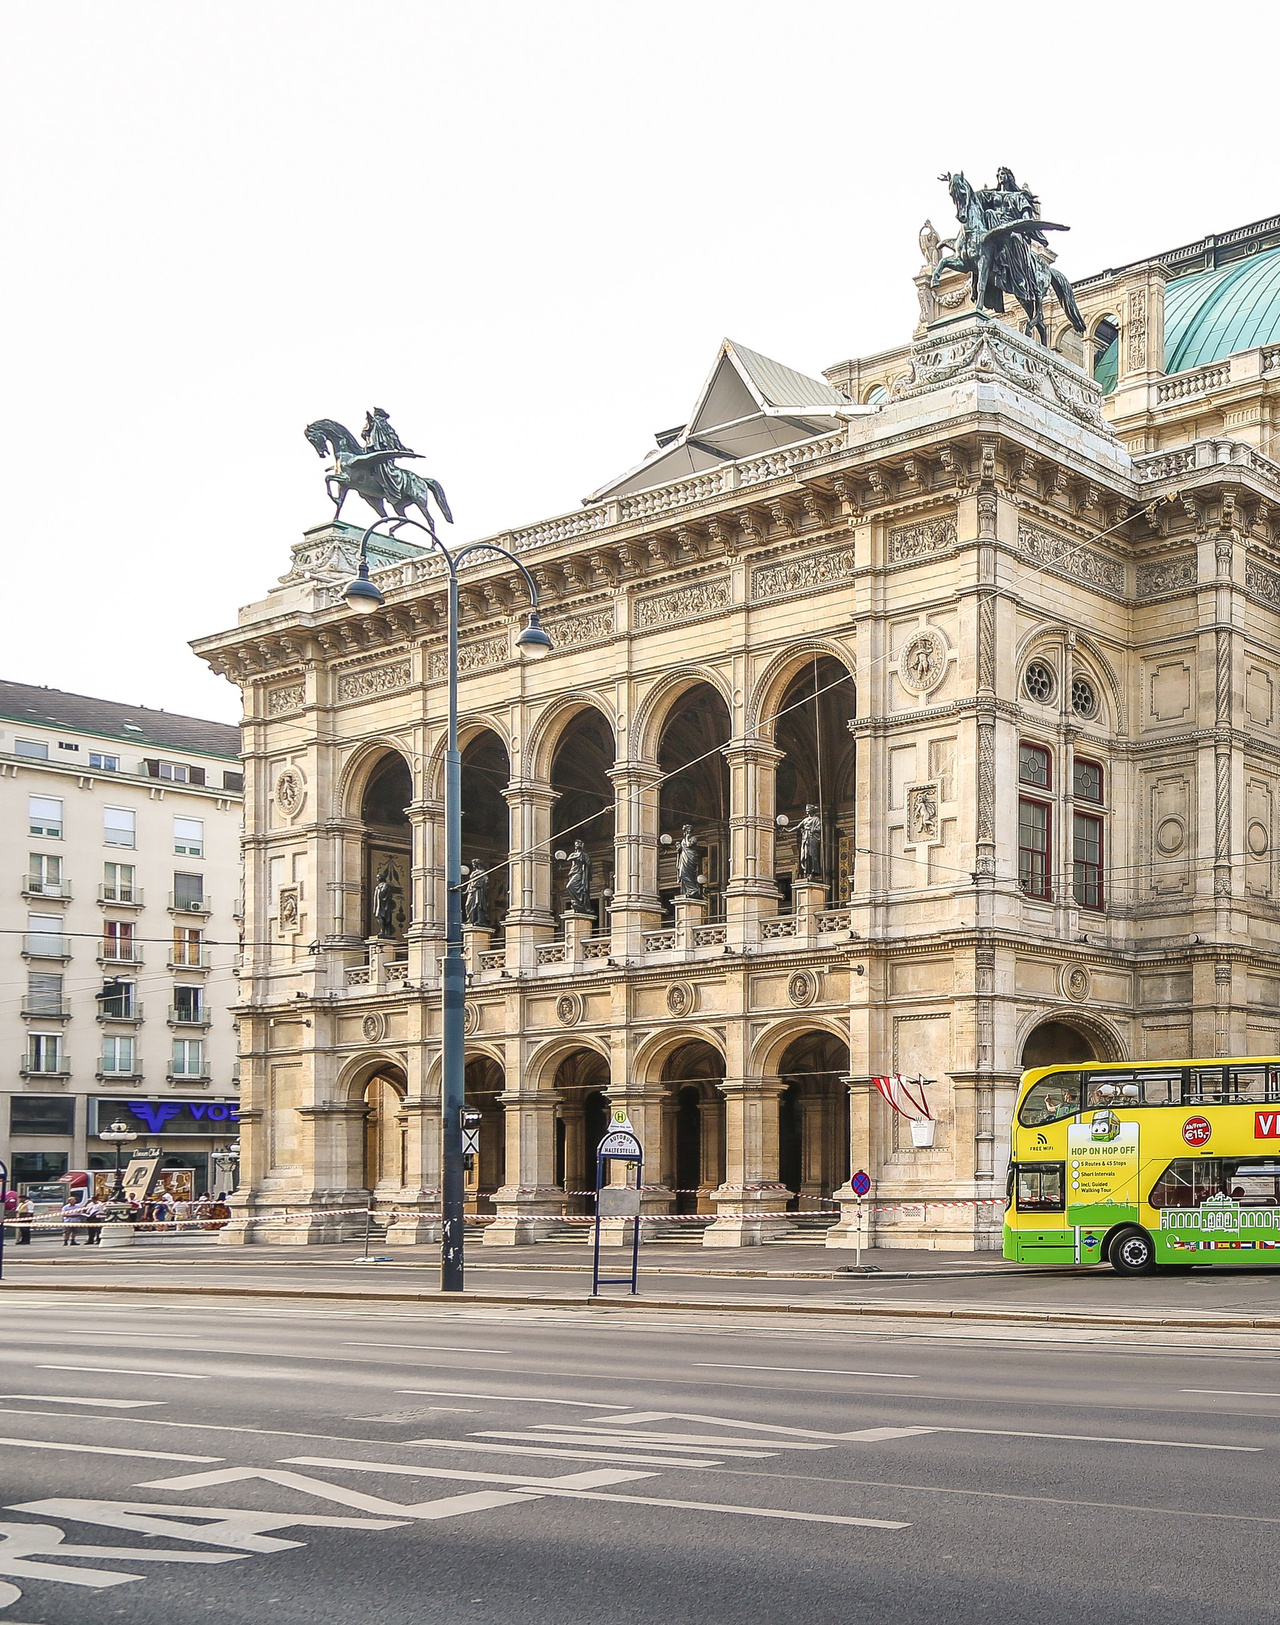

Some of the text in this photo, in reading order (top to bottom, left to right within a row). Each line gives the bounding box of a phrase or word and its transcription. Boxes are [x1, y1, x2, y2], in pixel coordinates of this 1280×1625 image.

[609, 1134, 633, 1145] AUTOBUS
[1071, 1146, 1136, 1156] HOP ON HOP OFF
[0, 1467, 548, 1609] RAZ
